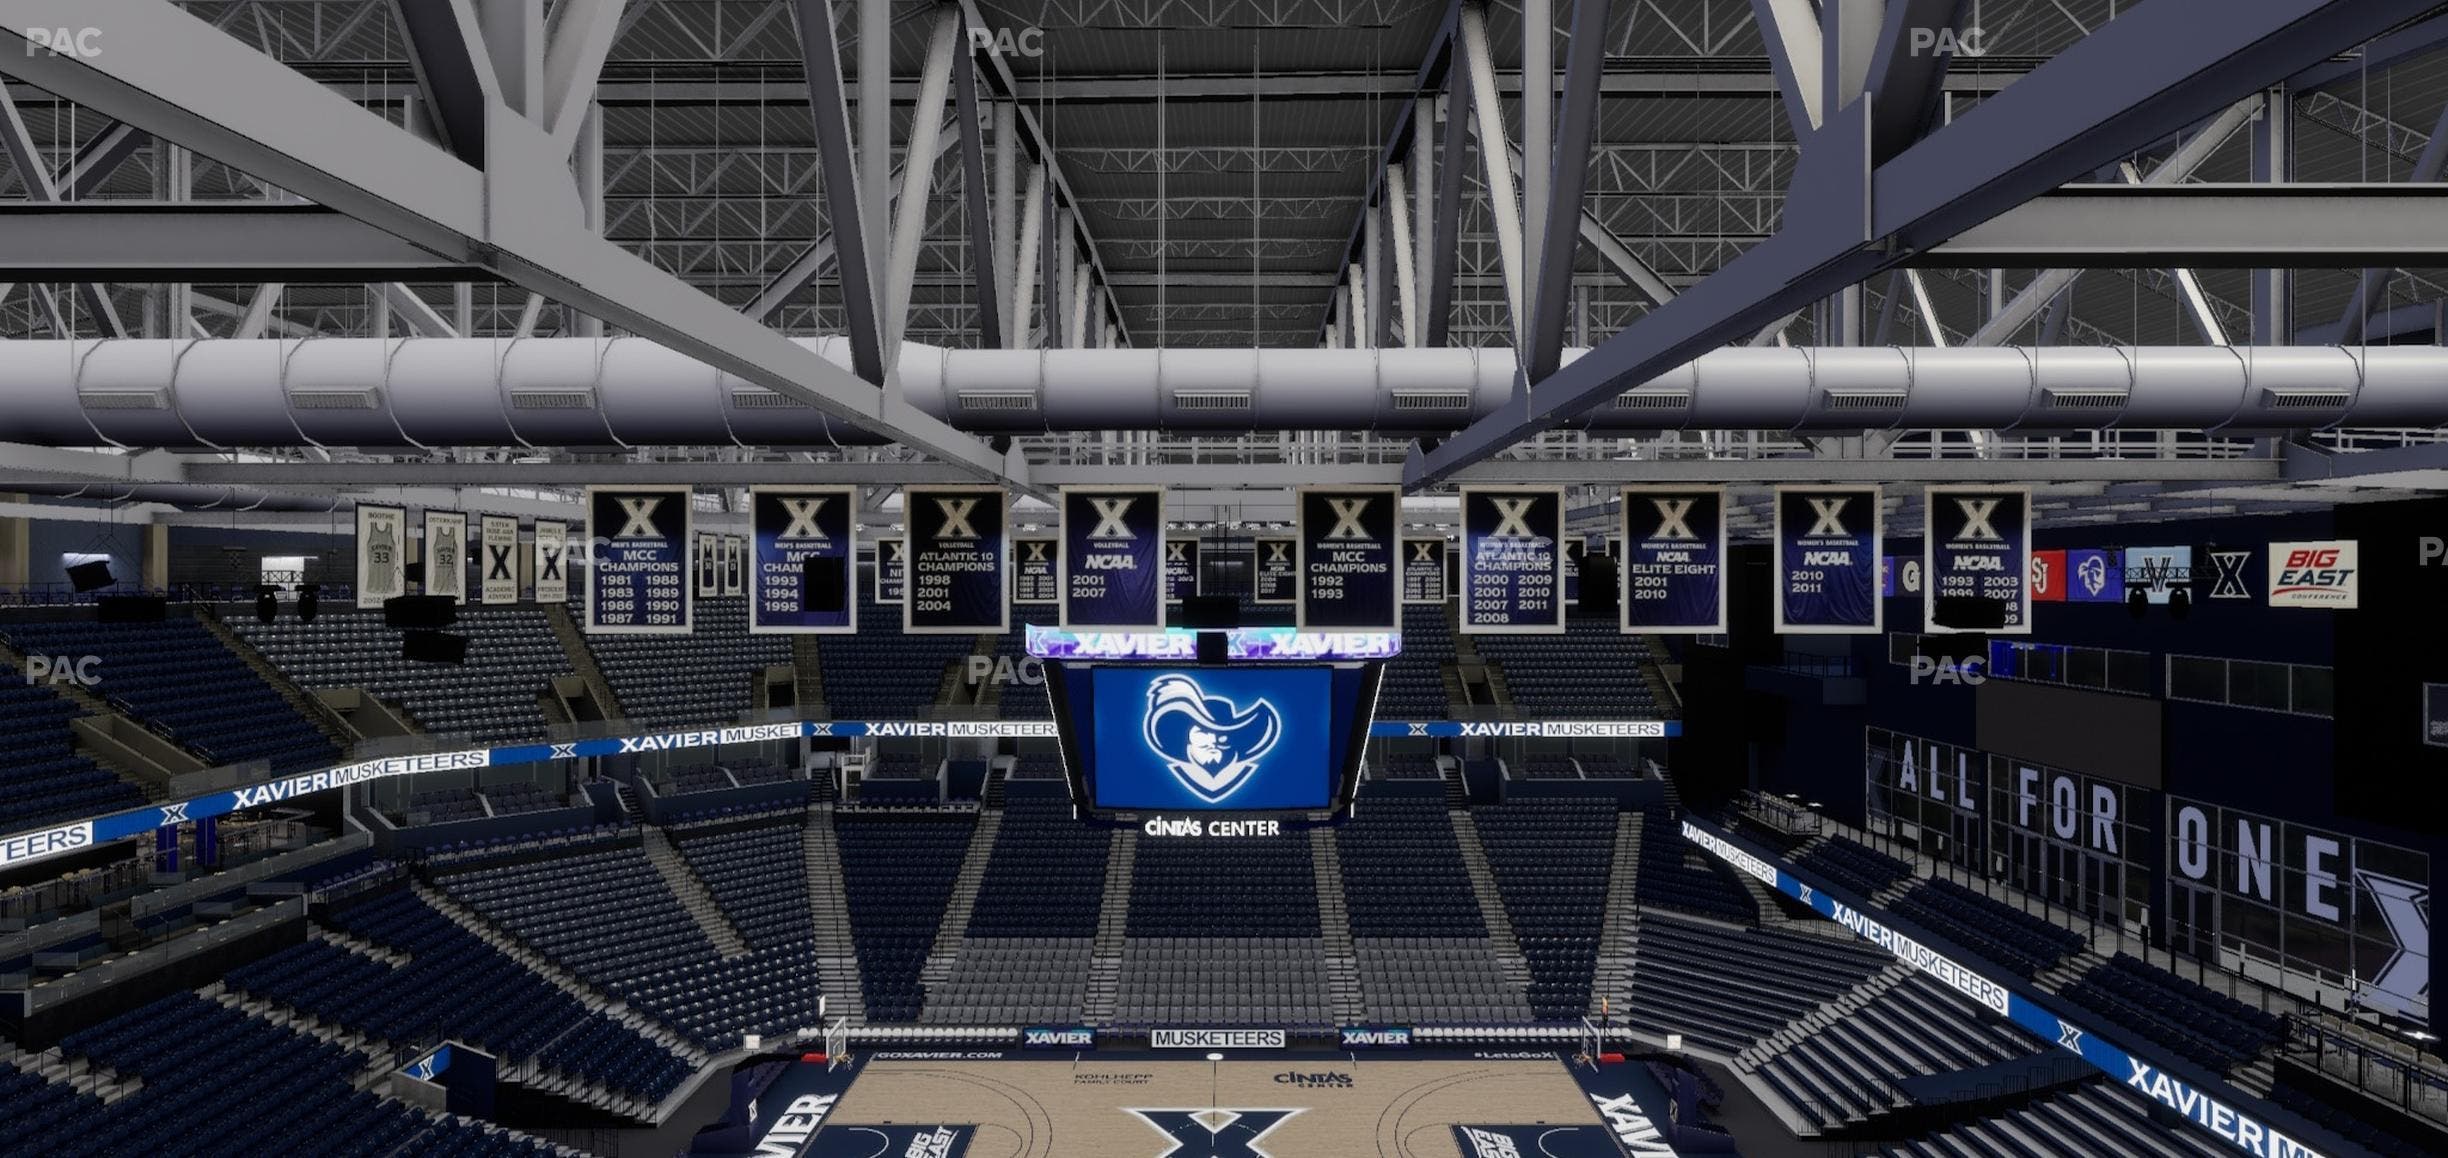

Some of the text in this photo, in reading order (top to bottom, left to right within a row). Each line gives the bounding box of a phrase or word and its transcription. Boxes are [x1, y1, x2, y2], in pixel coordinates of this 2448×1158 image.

[373, 552, 390, 563] 33
[439, 555, 453, 564] 32
[623, 550, 657, 560] MCC
[919, 552, 994, 561] ATLANTIC 10
[1332, 552, 1365, 562] MCC
[1476, 552, 1550, 561] ATLANTIC 10
[2286, 549, 2340, 568] BIG
[489, 544, 511, 580] X
[600, 562, 679, 572] CHAMPIONS
[918, 562, 995, 572] CHAMPIONS
[1475, 562, 1551, 571] CHAMPIONS
[1310, 563, 1387, 573] CHAMPIONS
[1632, 564, 1716, 574] ELITE EIGHT
[601, 575, 679, 585] 1981 1988
[919, 575, 951, 585] 1998
[1072, 575, 1105, 585] 2001
[1474, 575, 1552, 585] 2000 2009
[1792, 571, 1824, 580] 2010
[2209, 551, 2251, 599] X
[2277, 569, 2355, 586] EAST
[765, 576, 798, 586] 1993
[1312, 576, 1343, 586] 1992
[1635, 577, 1667, 587] 2001
[1942, 576, 2018, 586] 1993 2003
[601, 588, 679, 598] 1983 1989
[917, 588, 949, 598] 2001
[1072, 588, 1106, 598] 2007
[1474, 588, 1550, 598] 2001 2010
[1792, 583, 1822, 593] 2011
[765, 589, 798, 599] 1994
[1312, 589, 1343, 599] 1993
[1635, 589, 1667, 599] 2010
[1984, 589, 2018, 599] 2007
[601, 601, 679, 611] 1986 1990
[765, 602, 798, 612] 1995
[917, 600, 951, 611] 2004
[1474, 600, 1547, 610] 2007 2011
[601, 614, 677, 624] 1987 1991
[1474, 613, 1509, 623] 2008
[1073, 632, 1195, 655] XAVIER
[1270, 632, 1391, 655] XAVIER
[865, 722, 946, 737] XAVIER
[952, 723, 1058, 736] MUSKETEER
[1460, 722, 1541, 736] XAVIER
[1547, 723, 1661, 736] MUSKETEERS
[619, 731, 720, 753] XAVIER
[232, 773, 328, 810] XAVIER
[335, 752, 485, 785] MUSKETEERS
[1145, 815, 1280, 837] CINTAS CENTER
[1900, 740, 2340, 922] ALL FOR ONE
[1682, 820, 1717, 853] XAVIER
[1719, 841, 1775, 884] MUSKETEERS
[1832, 900, 1893, 950] XAVIER
[1897, 936, 2005, 1010] MUSKETEERS
[2128, 1056, 2265, 1157] XAVIER
[1026, 1031, 1092, 1044] XAVIER
[1156, 1031, 1282, 1046] MUSKETEERS
[1342, 1031, 1409, 1044] XAVIER
[1474, 1051, 1554, 1059] #LetsGoX
